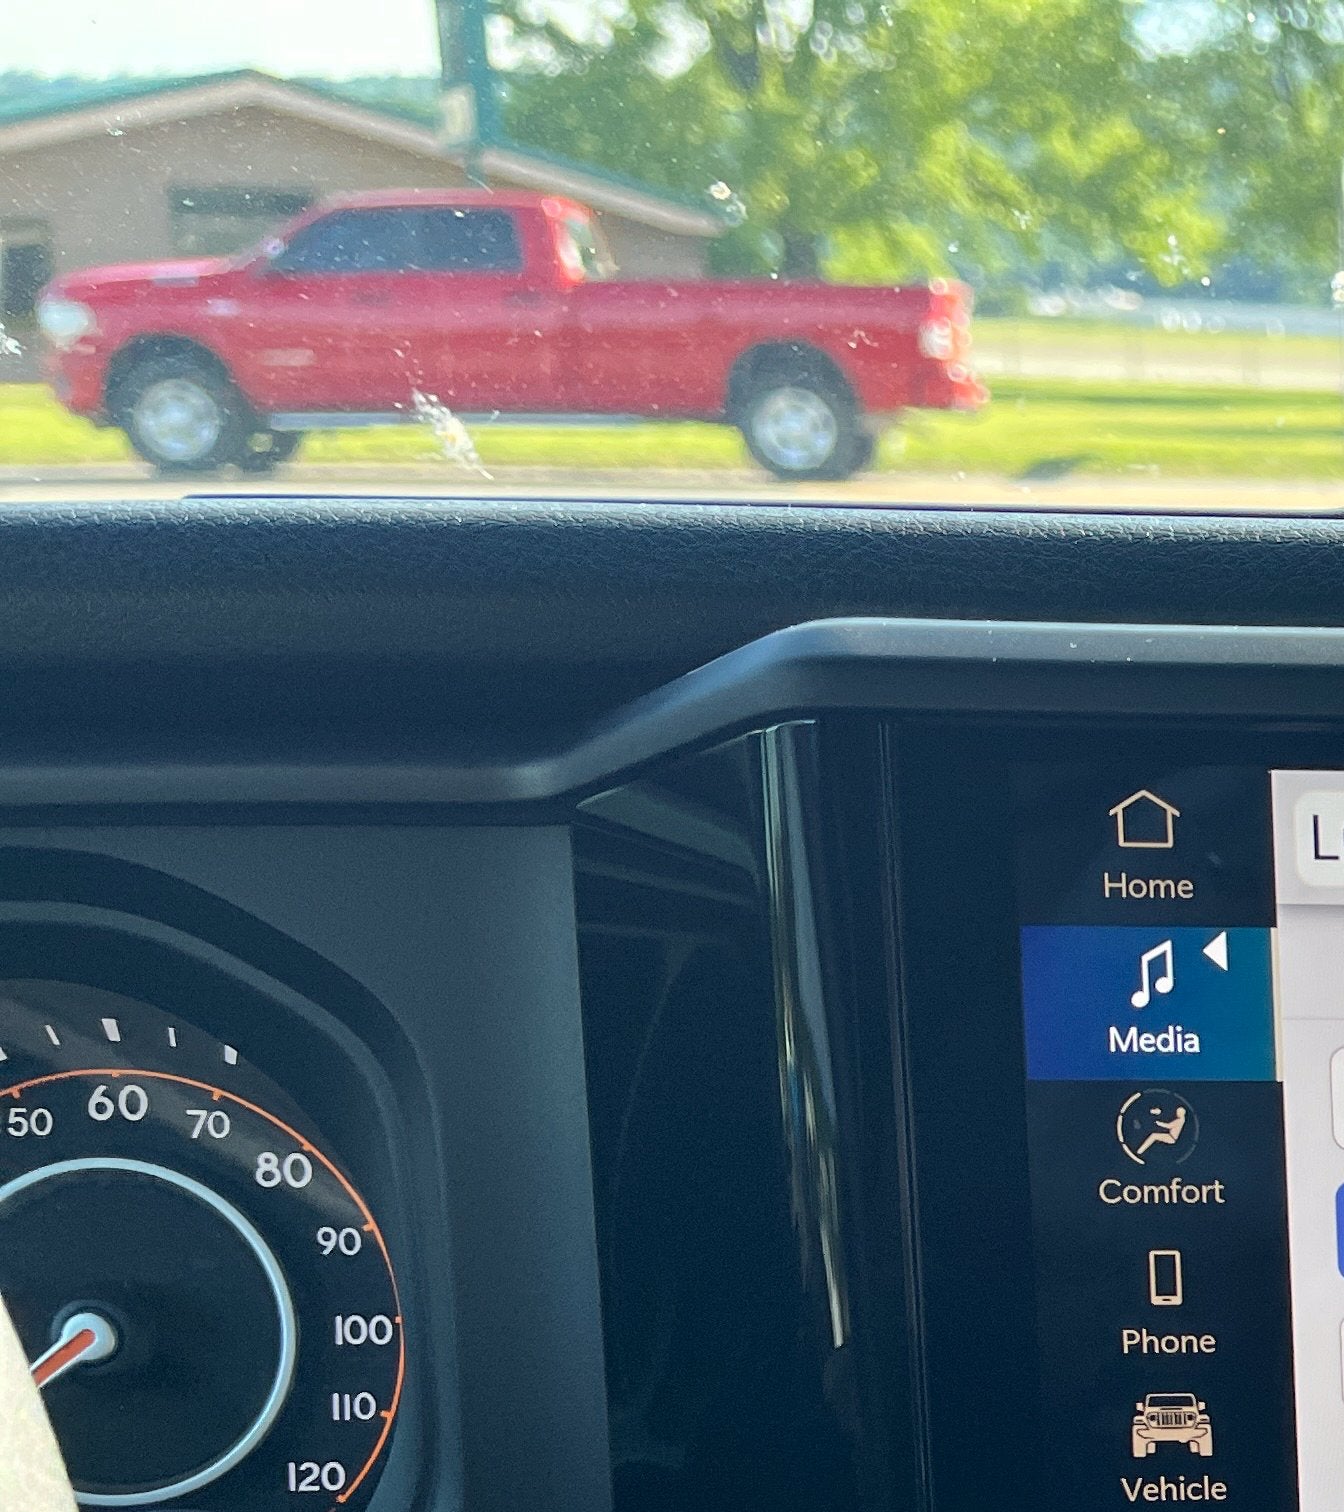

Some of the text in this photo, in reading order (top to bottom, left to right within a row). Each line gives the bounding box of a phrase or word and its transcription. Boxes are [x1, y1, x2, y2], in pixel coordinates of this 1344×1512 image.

[1103, 872, 1194, 899] Home
[1108, 1026, 1201, 1053] Media
[87, 1084, 149, 1122] 60
[7, 1107, 54, 1138] 50
[186, 1109, 231, 1139] 70
[255, 1152, 313, 1189] 80
[1099, 1178, 1225, 1205] Comfort
[316, 1226, 362, 1256] 90
[334, 1314, 394, 1346] 100
[1122, 1329, 1217, 1355] Phone
[331, 1390, 377, 1422] 110
[287, 1460, 346, 1493] 120
[1121, 1475, 1227, 1502] Vehicle
